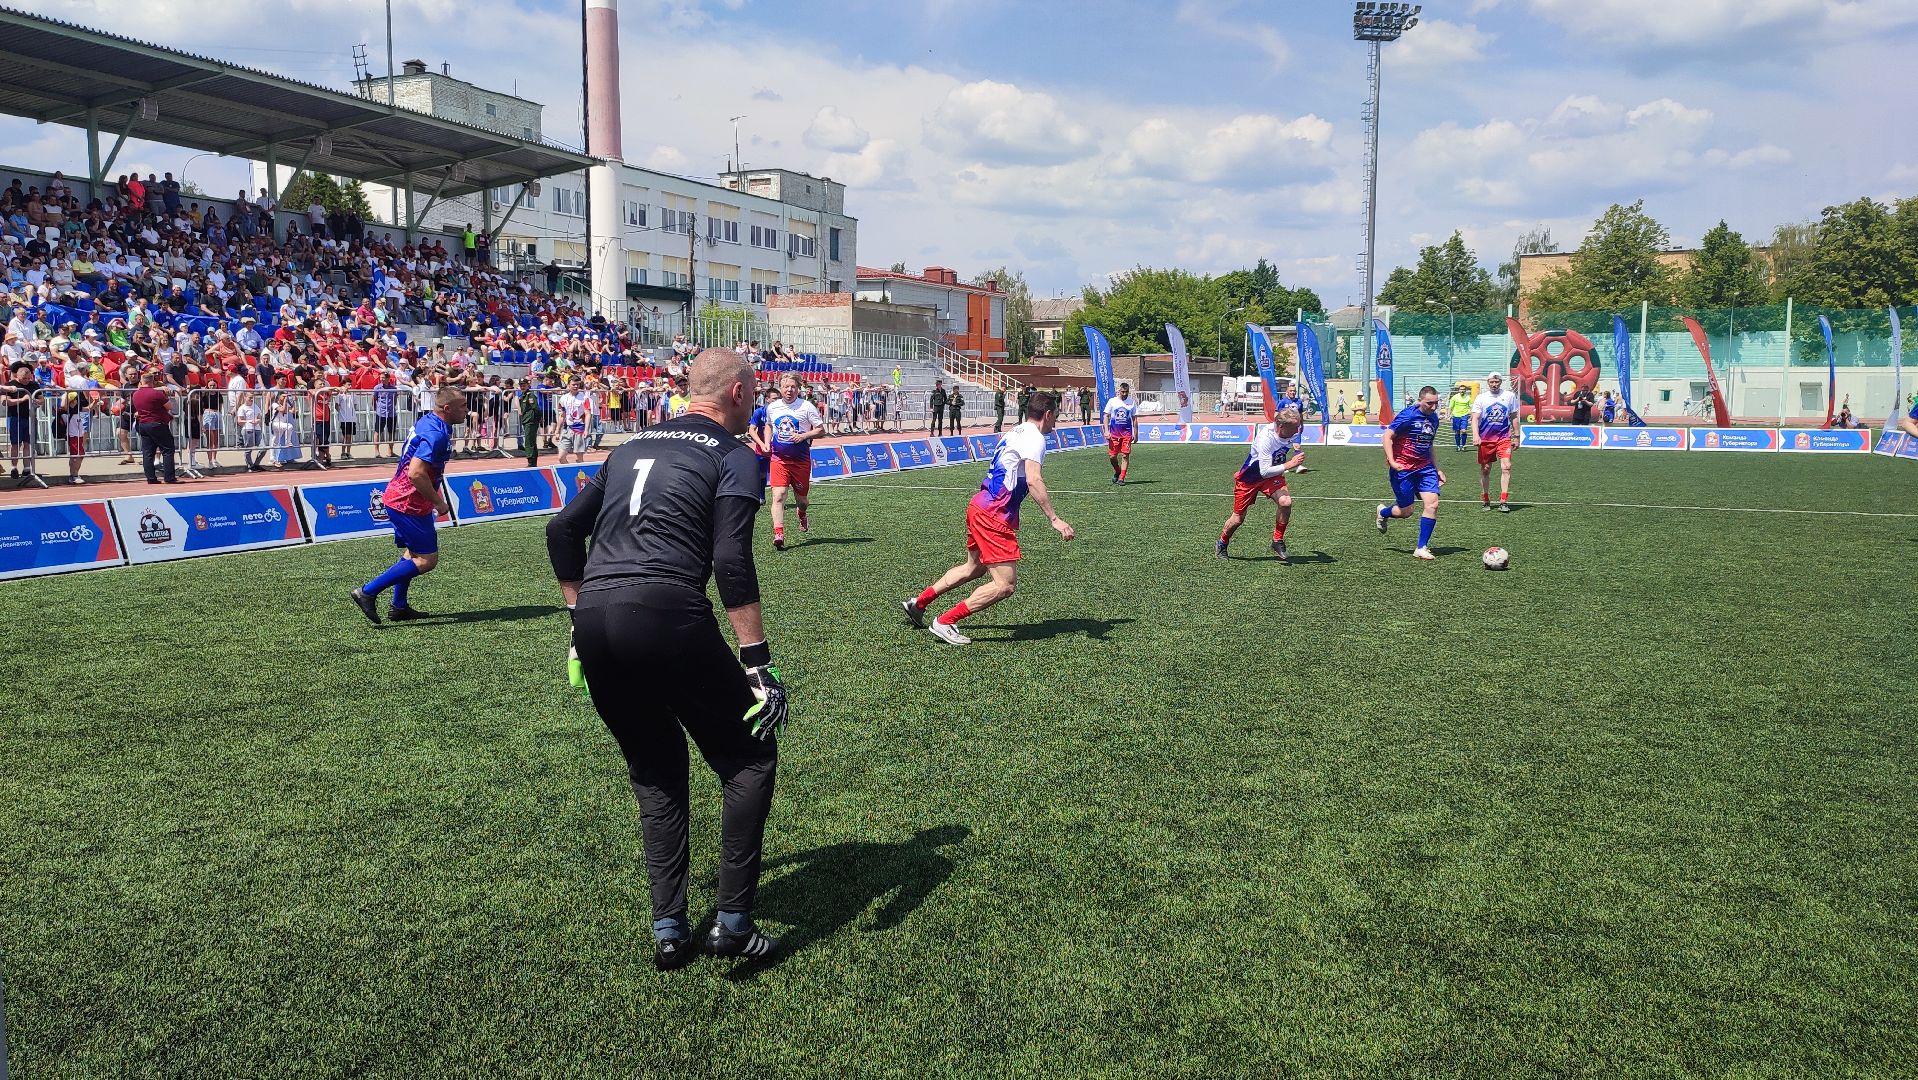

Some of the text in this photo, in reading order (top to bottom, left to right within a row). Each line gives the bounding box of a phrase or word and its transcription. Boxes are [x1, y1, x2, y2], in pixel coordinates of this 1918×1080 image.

[1812, 440, 1850, 448] Губернатора
[492, 485, 524, 495] Команда
[629, 458, 656, 516] 1
[495, 495, 540, 508] Губернатора
